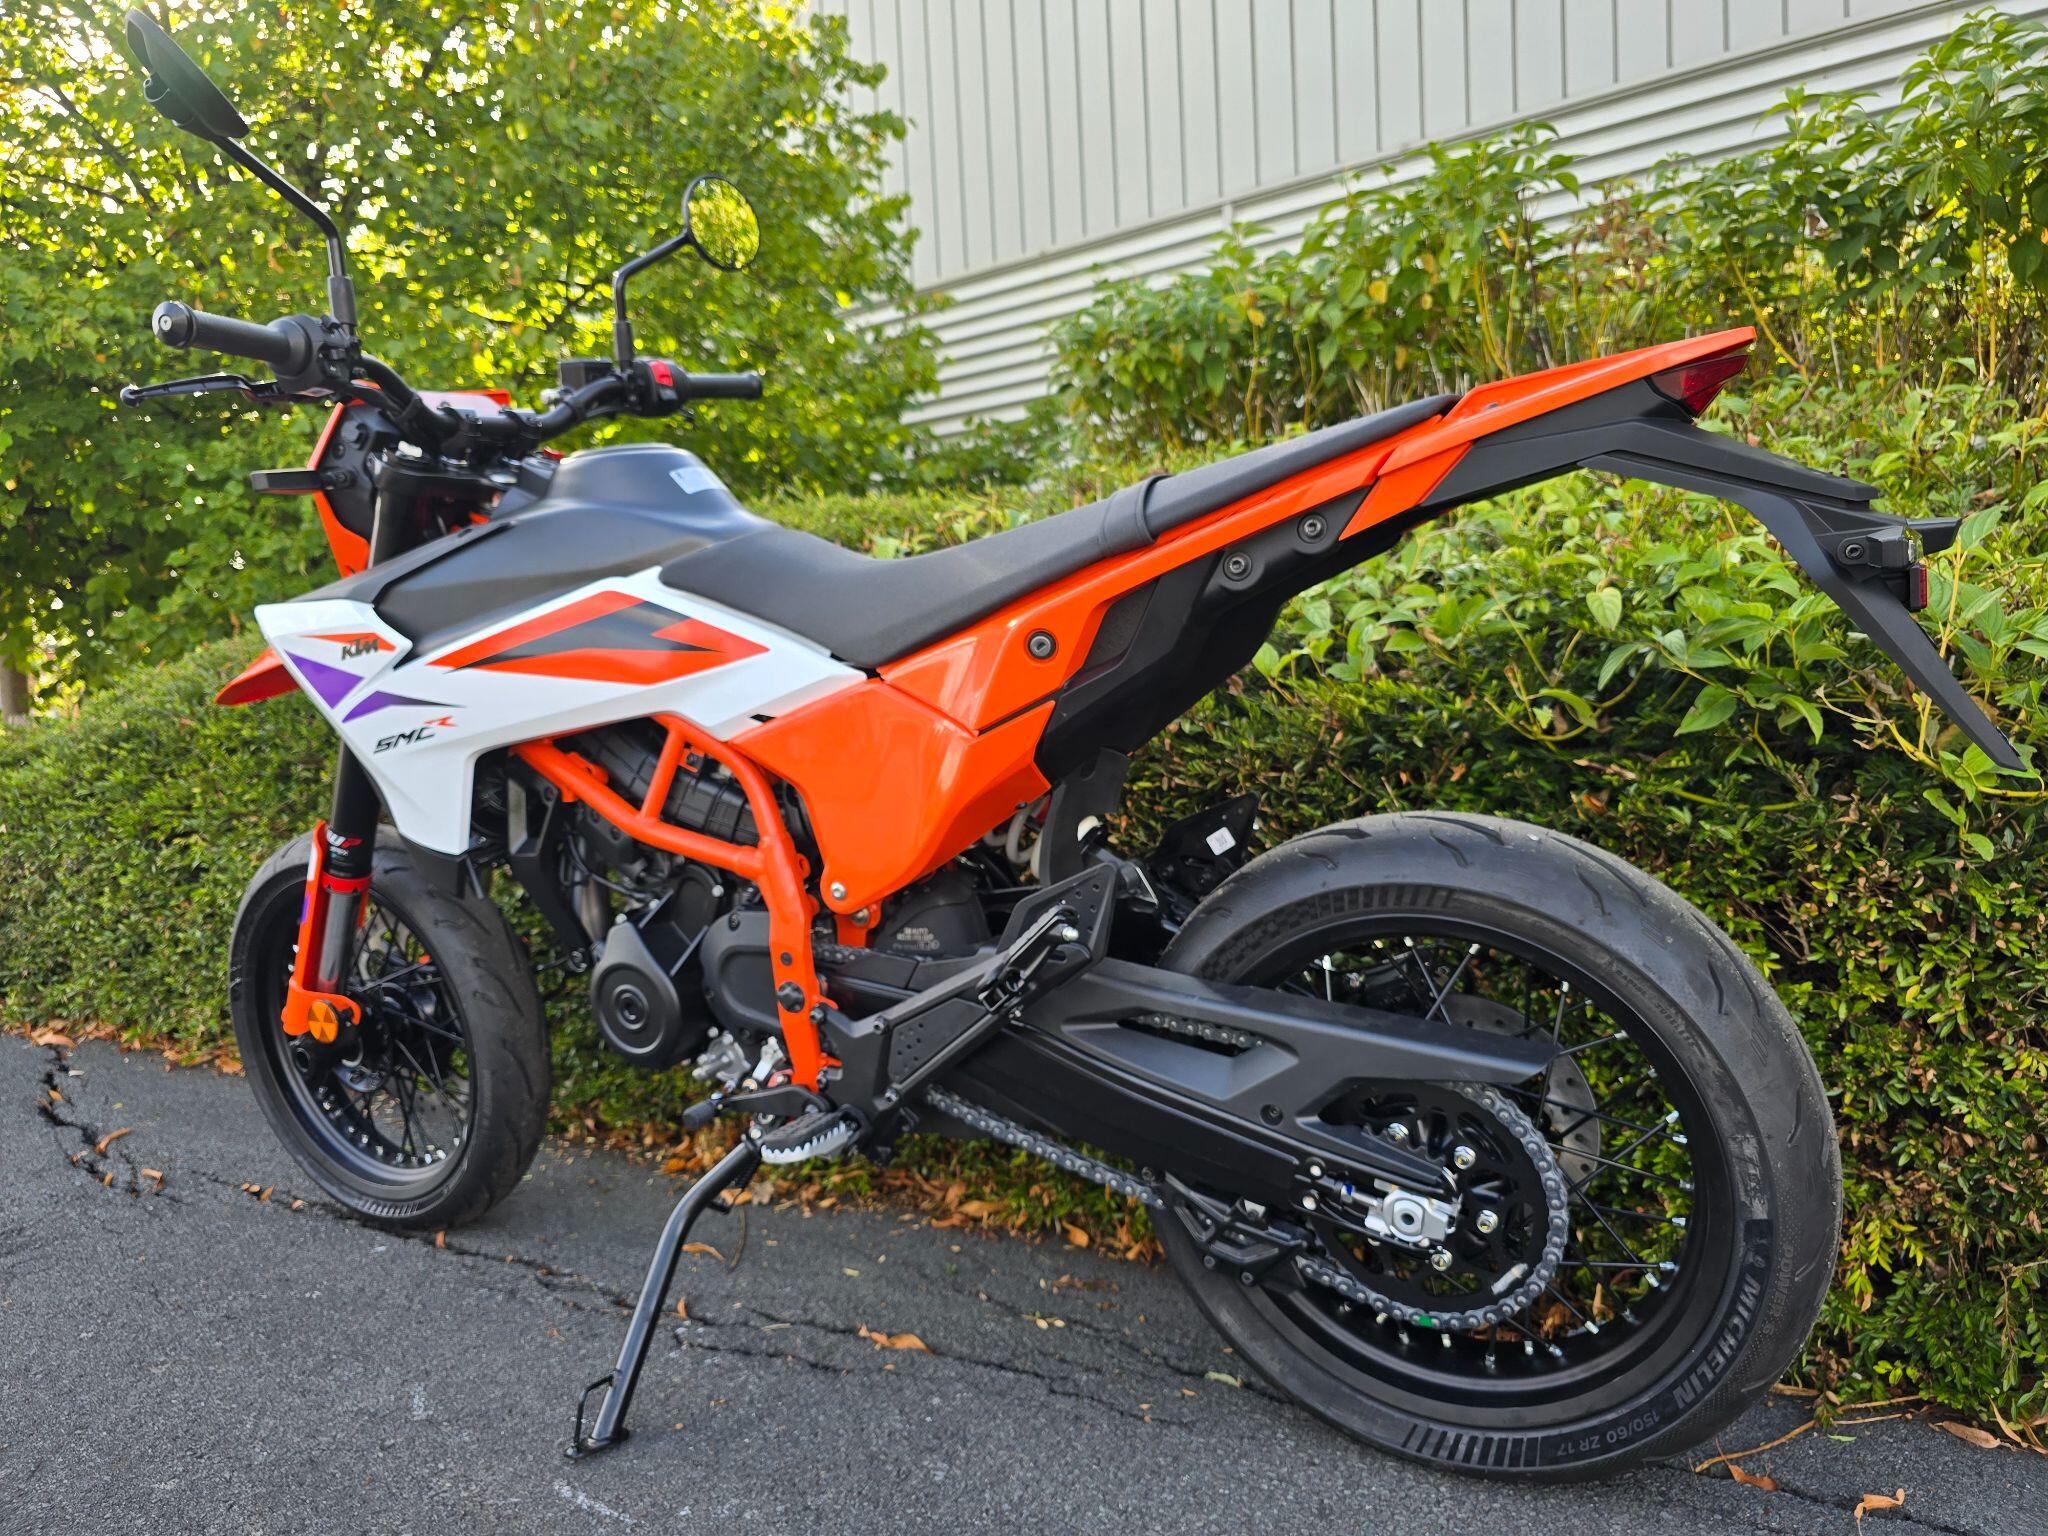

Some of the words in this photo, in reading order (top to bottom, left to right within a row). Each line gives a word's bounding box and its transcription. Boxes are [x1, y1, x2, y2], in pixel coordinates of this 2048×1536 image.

[342, 638, 379, 661] KTM
[373, 727, 436, 754] SMC
[1672, 1272, 1761, 1409] MICHELIN
[1606, 1410, 1661, 1444] 150/60
[1557, 1442, 1575, 1456] 17
[1579, 1435, 1600, 1452] ZR
